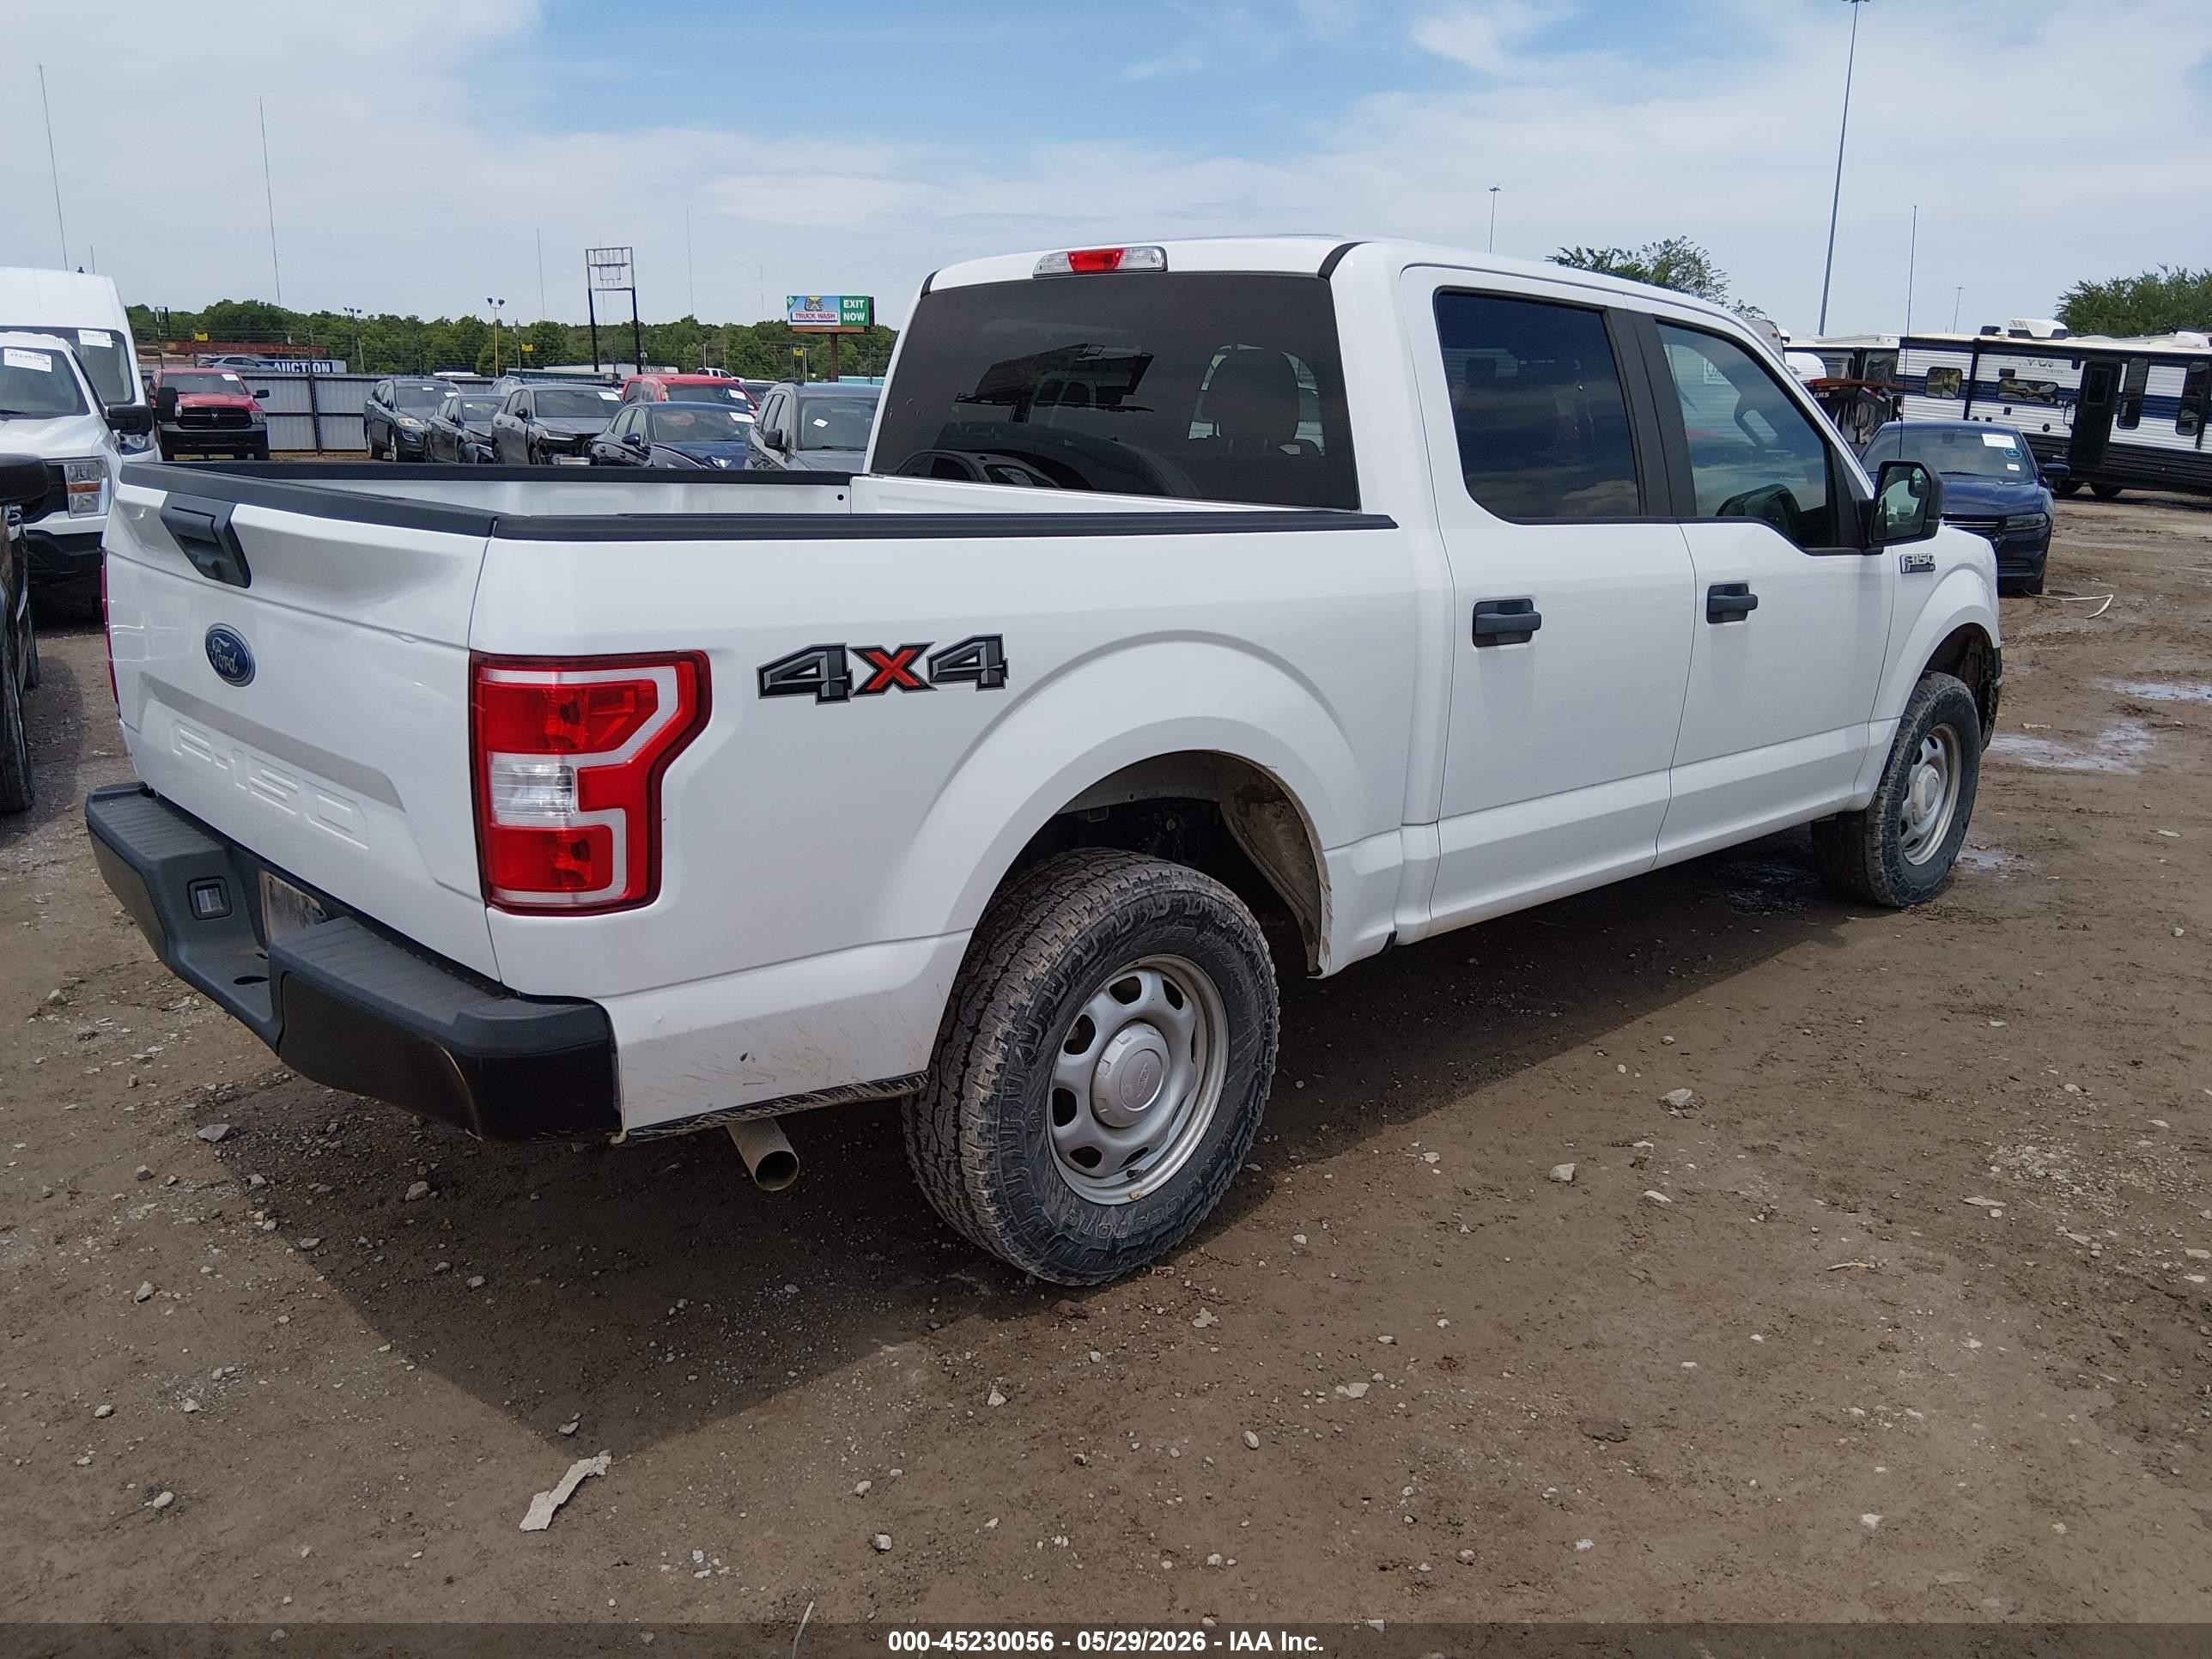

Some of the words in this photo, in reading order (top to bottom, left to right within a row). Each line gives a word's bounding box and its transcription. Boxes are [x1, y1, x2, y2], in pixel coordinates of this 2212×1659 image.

[843, 300, 865, 309] EXIT
[843, 313, 865, 321] NOW
[274, 362, 331, 373] AUCTION
[211, 636, 239, 674] Ford
[757, 633, 1009, 706] 4X4
[170, 719, 368, 849] F-150
